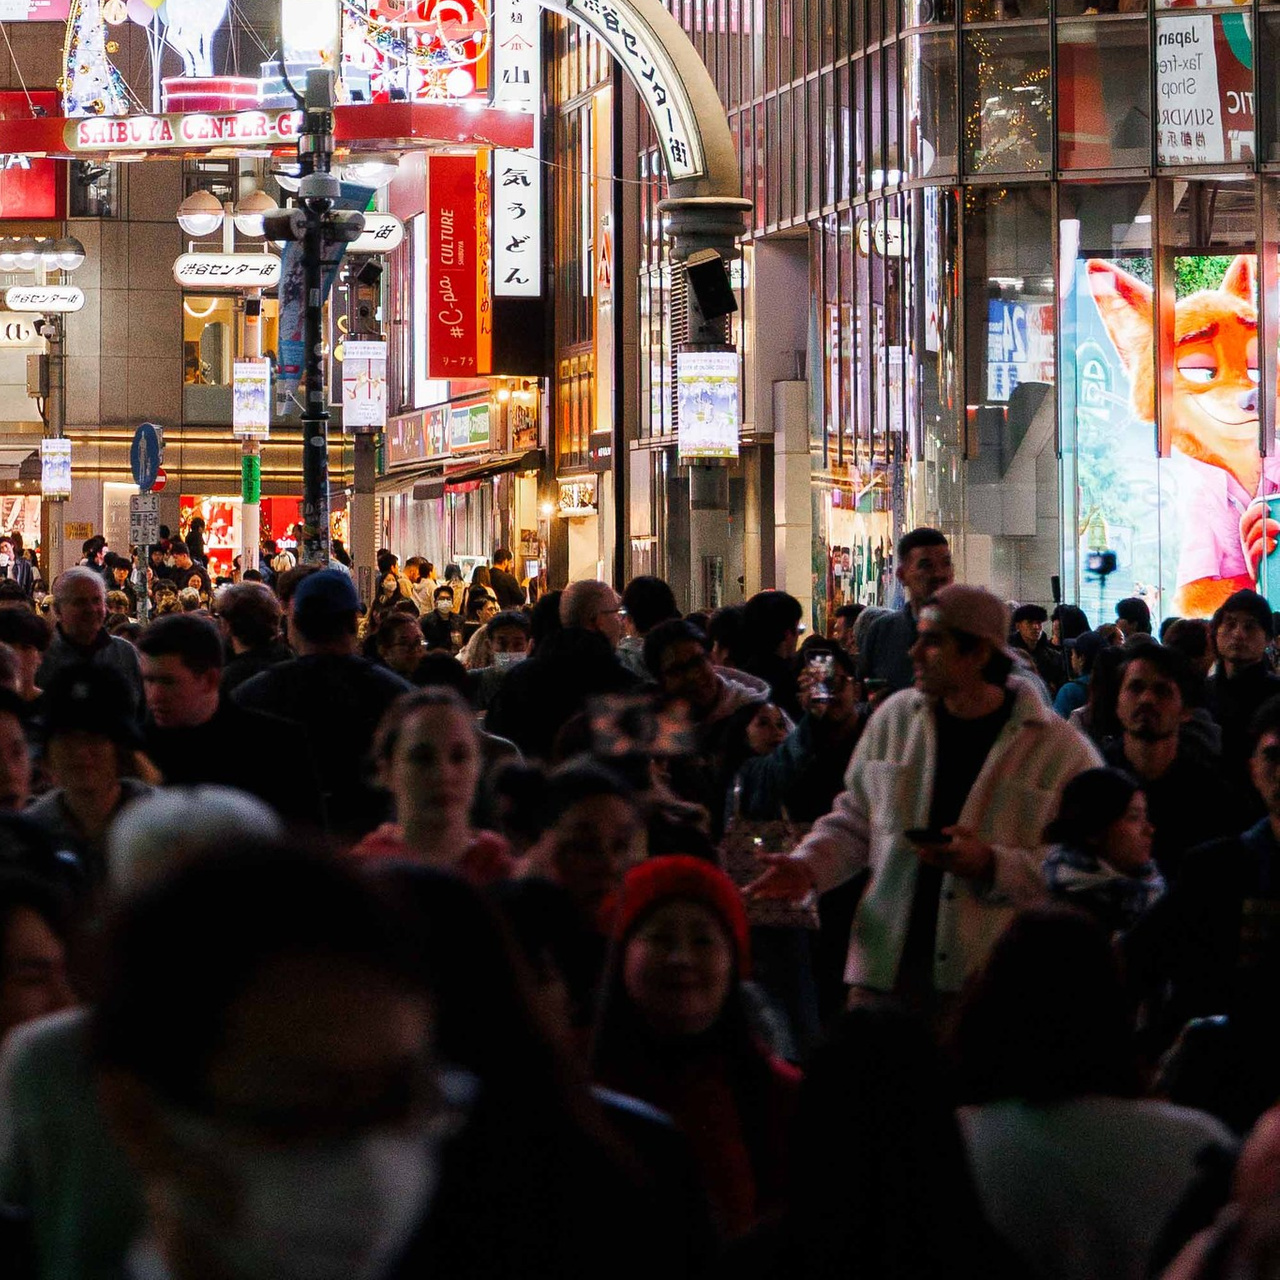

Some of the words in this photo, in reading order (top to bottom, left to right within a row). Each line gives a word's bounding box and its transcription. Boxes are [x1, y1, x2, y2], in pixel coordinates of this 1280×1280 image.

[183, 111, 302, 141] CENTER-G
[440, 207, 455, 265] CULTURE
[179, 264, 276, 277] 渋谷センター街
[9, 294, 79, 305] 渋谷センター街
